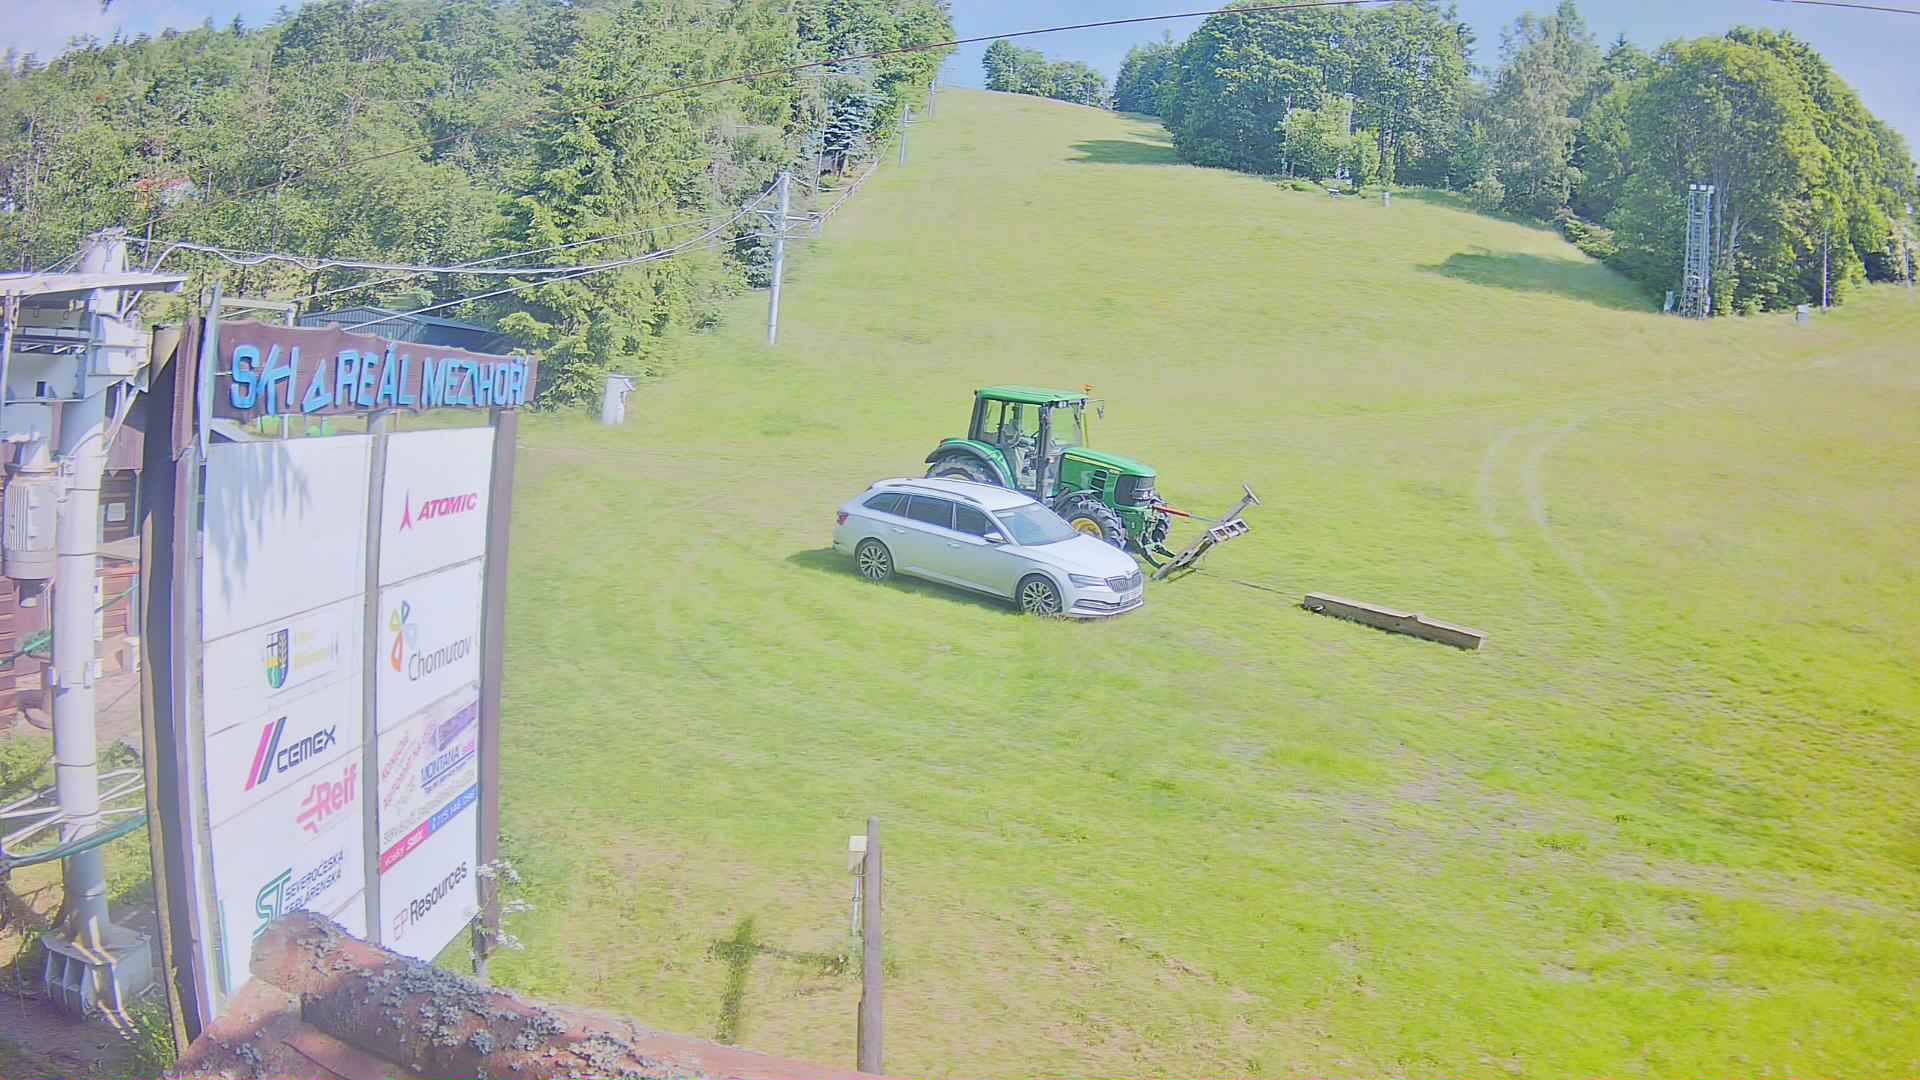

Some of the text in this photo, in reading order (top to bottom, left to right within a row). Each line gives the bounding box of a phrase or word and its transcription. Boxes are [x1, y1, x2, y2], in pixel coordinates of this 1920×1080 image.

[417, 492, 478, 522] ATOMIC
[408, 635, 473, 682] Chomutov
[276, 724, 337, 774] CEMEX
[315, 762, 358, 821] Reif
[409, 860, 468, 927] Resources
